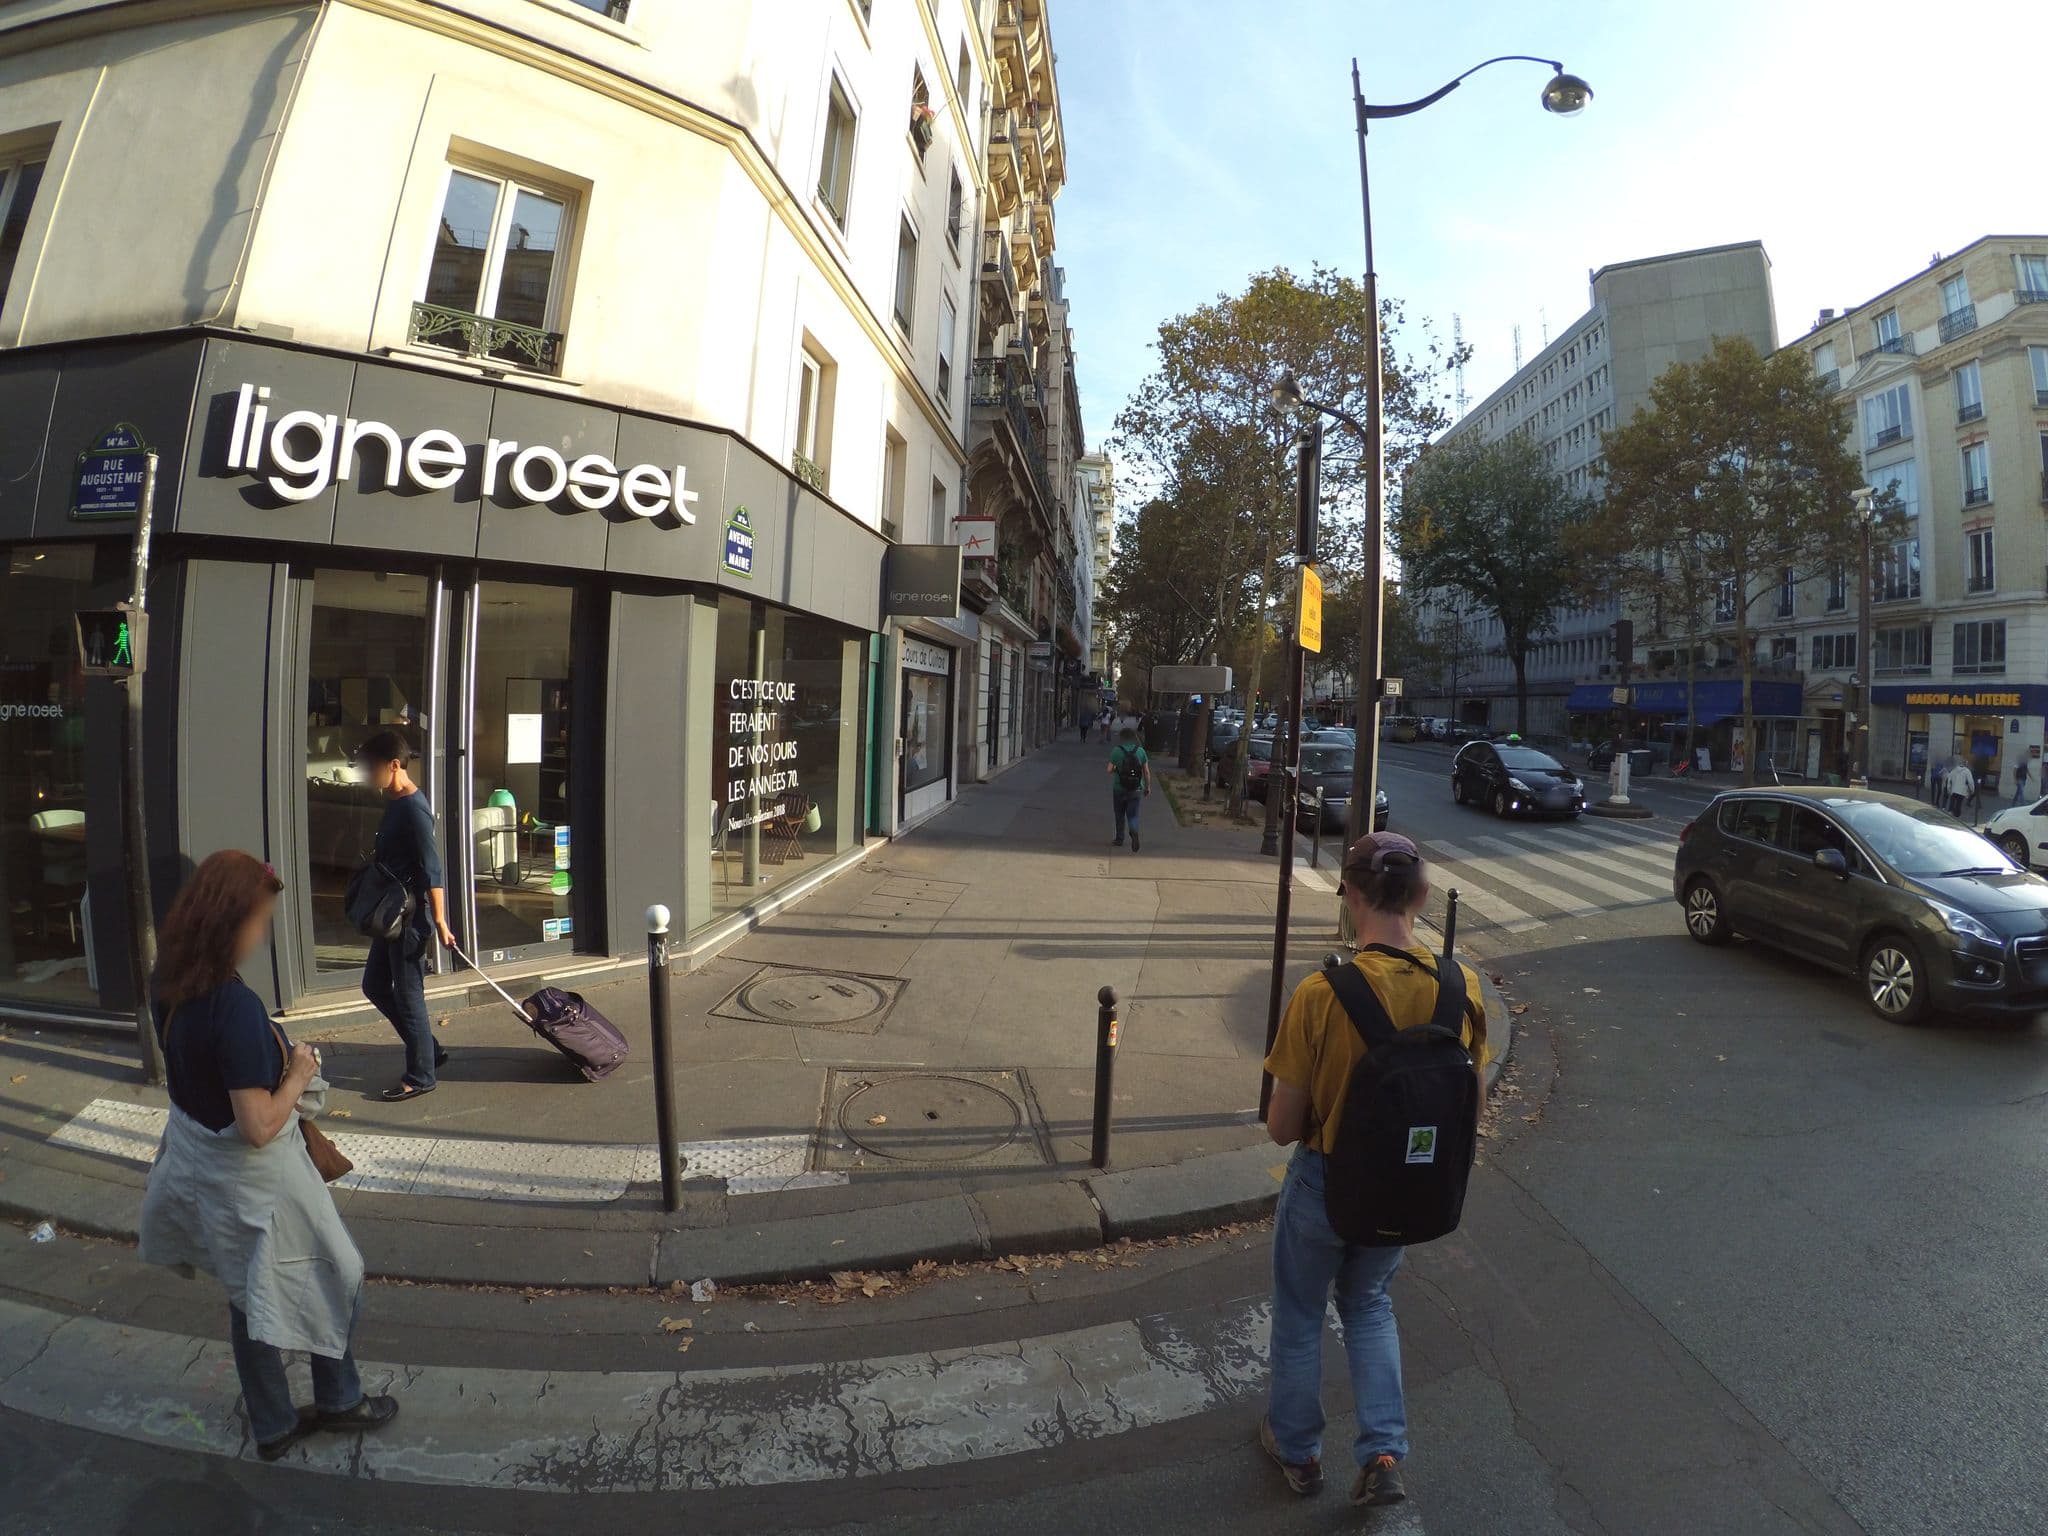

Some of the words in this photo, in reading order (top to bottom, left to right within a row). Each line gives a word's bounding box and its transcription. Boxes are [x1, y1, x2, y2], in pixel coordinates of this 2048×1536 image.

[227, 383, 467, 501] ligne
[482, 438, 699, 525] roset
[103, 459, 124, 471] RUE
[728, 529, 753, 549] AVENUE
[728, 552, 750, 570] MAINE
[889, 591, 919, 604] ligne
[920, 591, 953, 602] roset
[730, 678, 760, 700] C'EST
[761, 680, 775, 700] CE
[775, 681, 796, 704] QUE
[1906, 693, 1950, 705] MAISON
[1975, 693, 2021, 706] LITERIE
[27, 703, 63, 718] roset
[729, 712, 778, 733] FERAIENT
[729, 746, 744, 768] DE
[746, 744, 769, 766] NOS
[769, 740, 798, 767] JOURS
[728, 779, 746, 803] LES
[748, 768, 786, 798] ANNÉES
[787, 769, 799, 789] 70.
